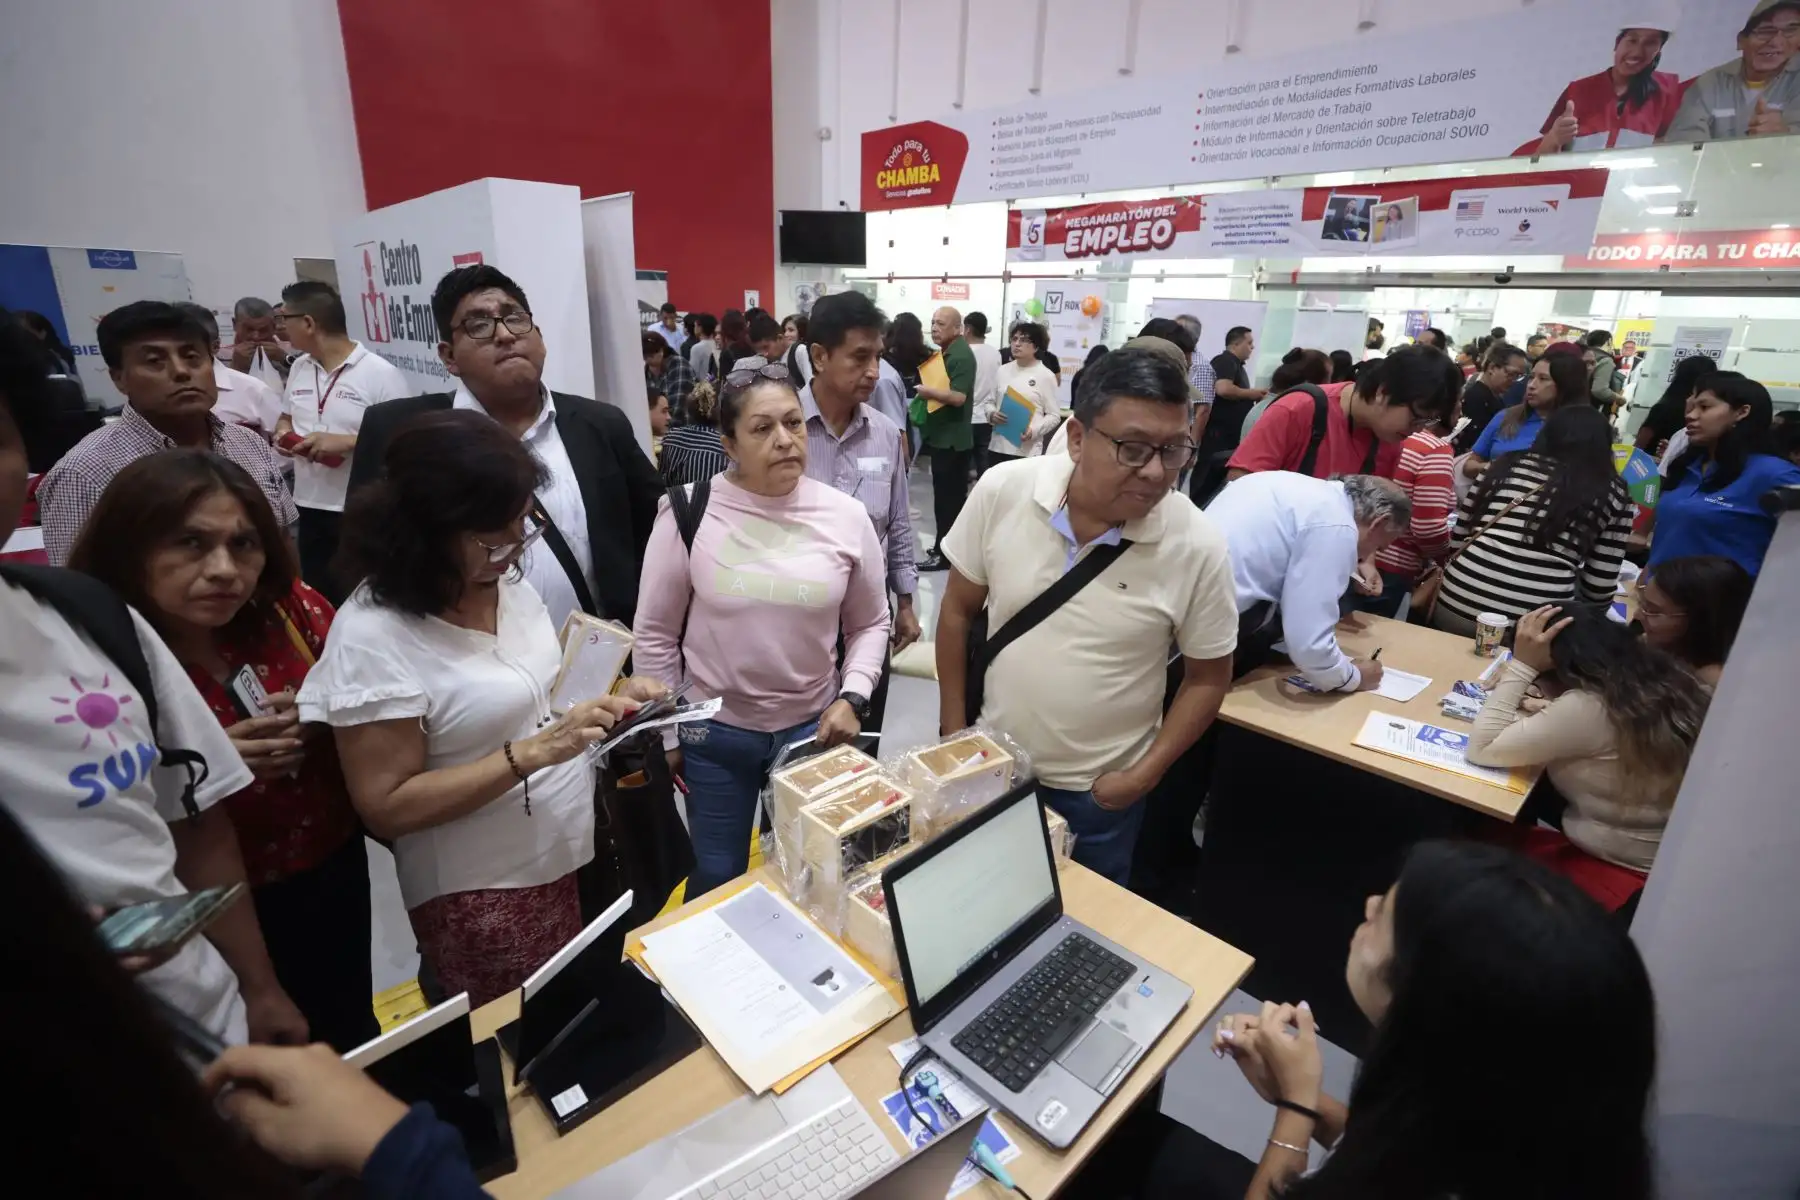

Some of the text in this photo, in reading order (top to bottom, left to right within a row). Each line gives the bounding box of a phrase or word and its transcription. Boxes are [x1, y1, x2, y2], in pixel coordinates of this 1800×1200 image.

[1205, 68, 1476, 115] Intermediación de Modalidades Formativas Laborales
[1206, 64, 1378, 100] Orientación para el Emprendimiento
[1201, 106, 1476, 148] Módulo de Información y Orientación sobre Teletrabajo
[1202, 101, 1372, 132] Información del Mercado de Trabajo
[884, 139, 931, 168] Todo para tu
[1199, 123, 1489, 163] Orientación Vocacional e Información Ocupacional SOVIO
[876, 163, 941, 189] CHAMBA
[1065, 204, 1177, 228] MEGAMARATÓN DEL
[1497, 205, 1549, 214] World Vision
[1065, 218, 1173, 254] EMPLEO
[1587, 245, 1642, 261] TODO
[1645, 244, 1708, 260] PARA
[1717, 243, 1748, 259] TU
[380, 238, 422, 288] Centro
[389, 295, 404, 340] de
